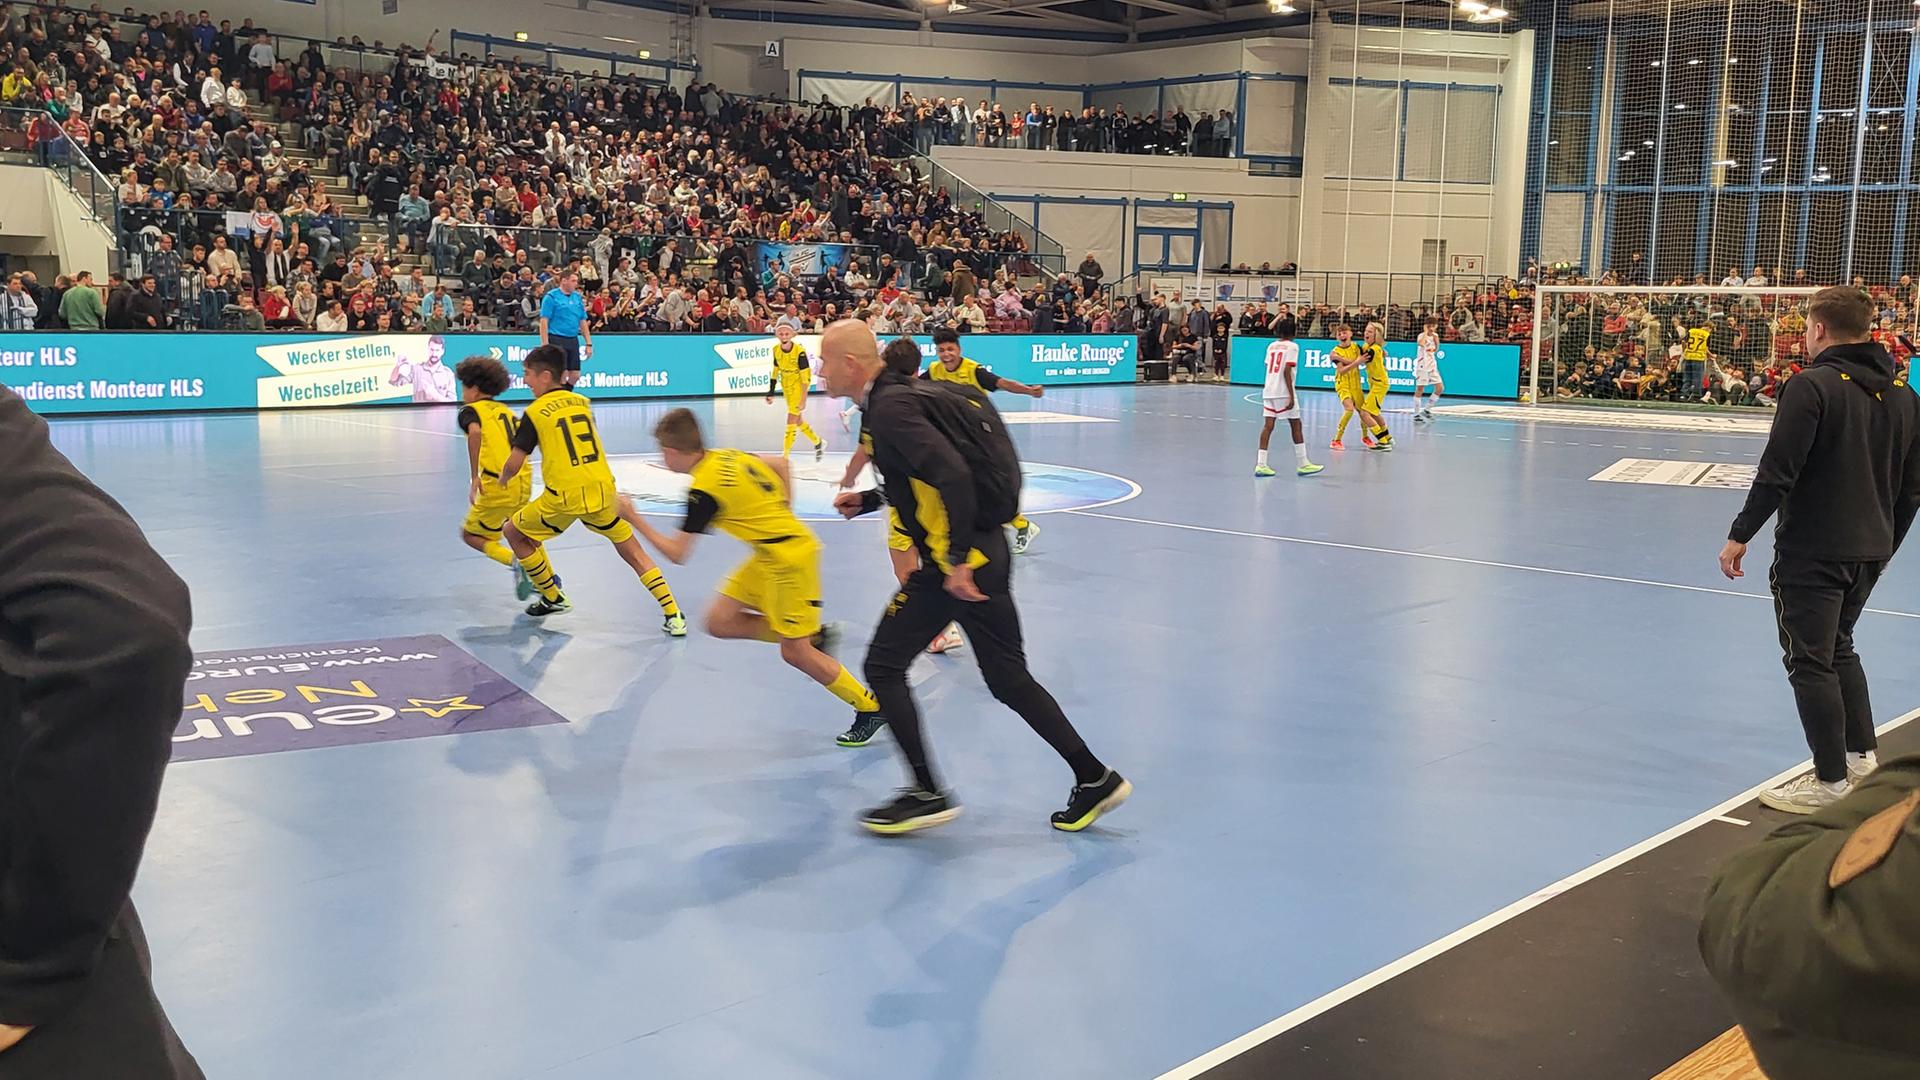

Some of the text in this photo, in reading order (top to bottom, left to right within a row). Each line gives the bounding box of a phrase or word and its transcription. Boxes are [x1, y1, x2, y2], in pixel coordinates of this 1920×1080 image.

[767, 42, 778, 56] A
[735, 347, 770, 361] Wecker
[1031, 342, 1125, 367] Hauke Runge
[1687, 336, 1705, 352] 27
[40, 346, 77, 367] HLS
[287, 344, 396, 366] Wecker stellen,
[1269, 351, 1283, 374] 19
[90, 379, 166, 399] Monteur
[170, 378, 204, 398] HLS
[278, 375, 379, 402] Wechselzeit!
[594, 374, 643, 388] Monteur
[646, 371, 669, 387] HLS
[498, 412, 521, 450] 1
[556, 413, 599, 467] 13
